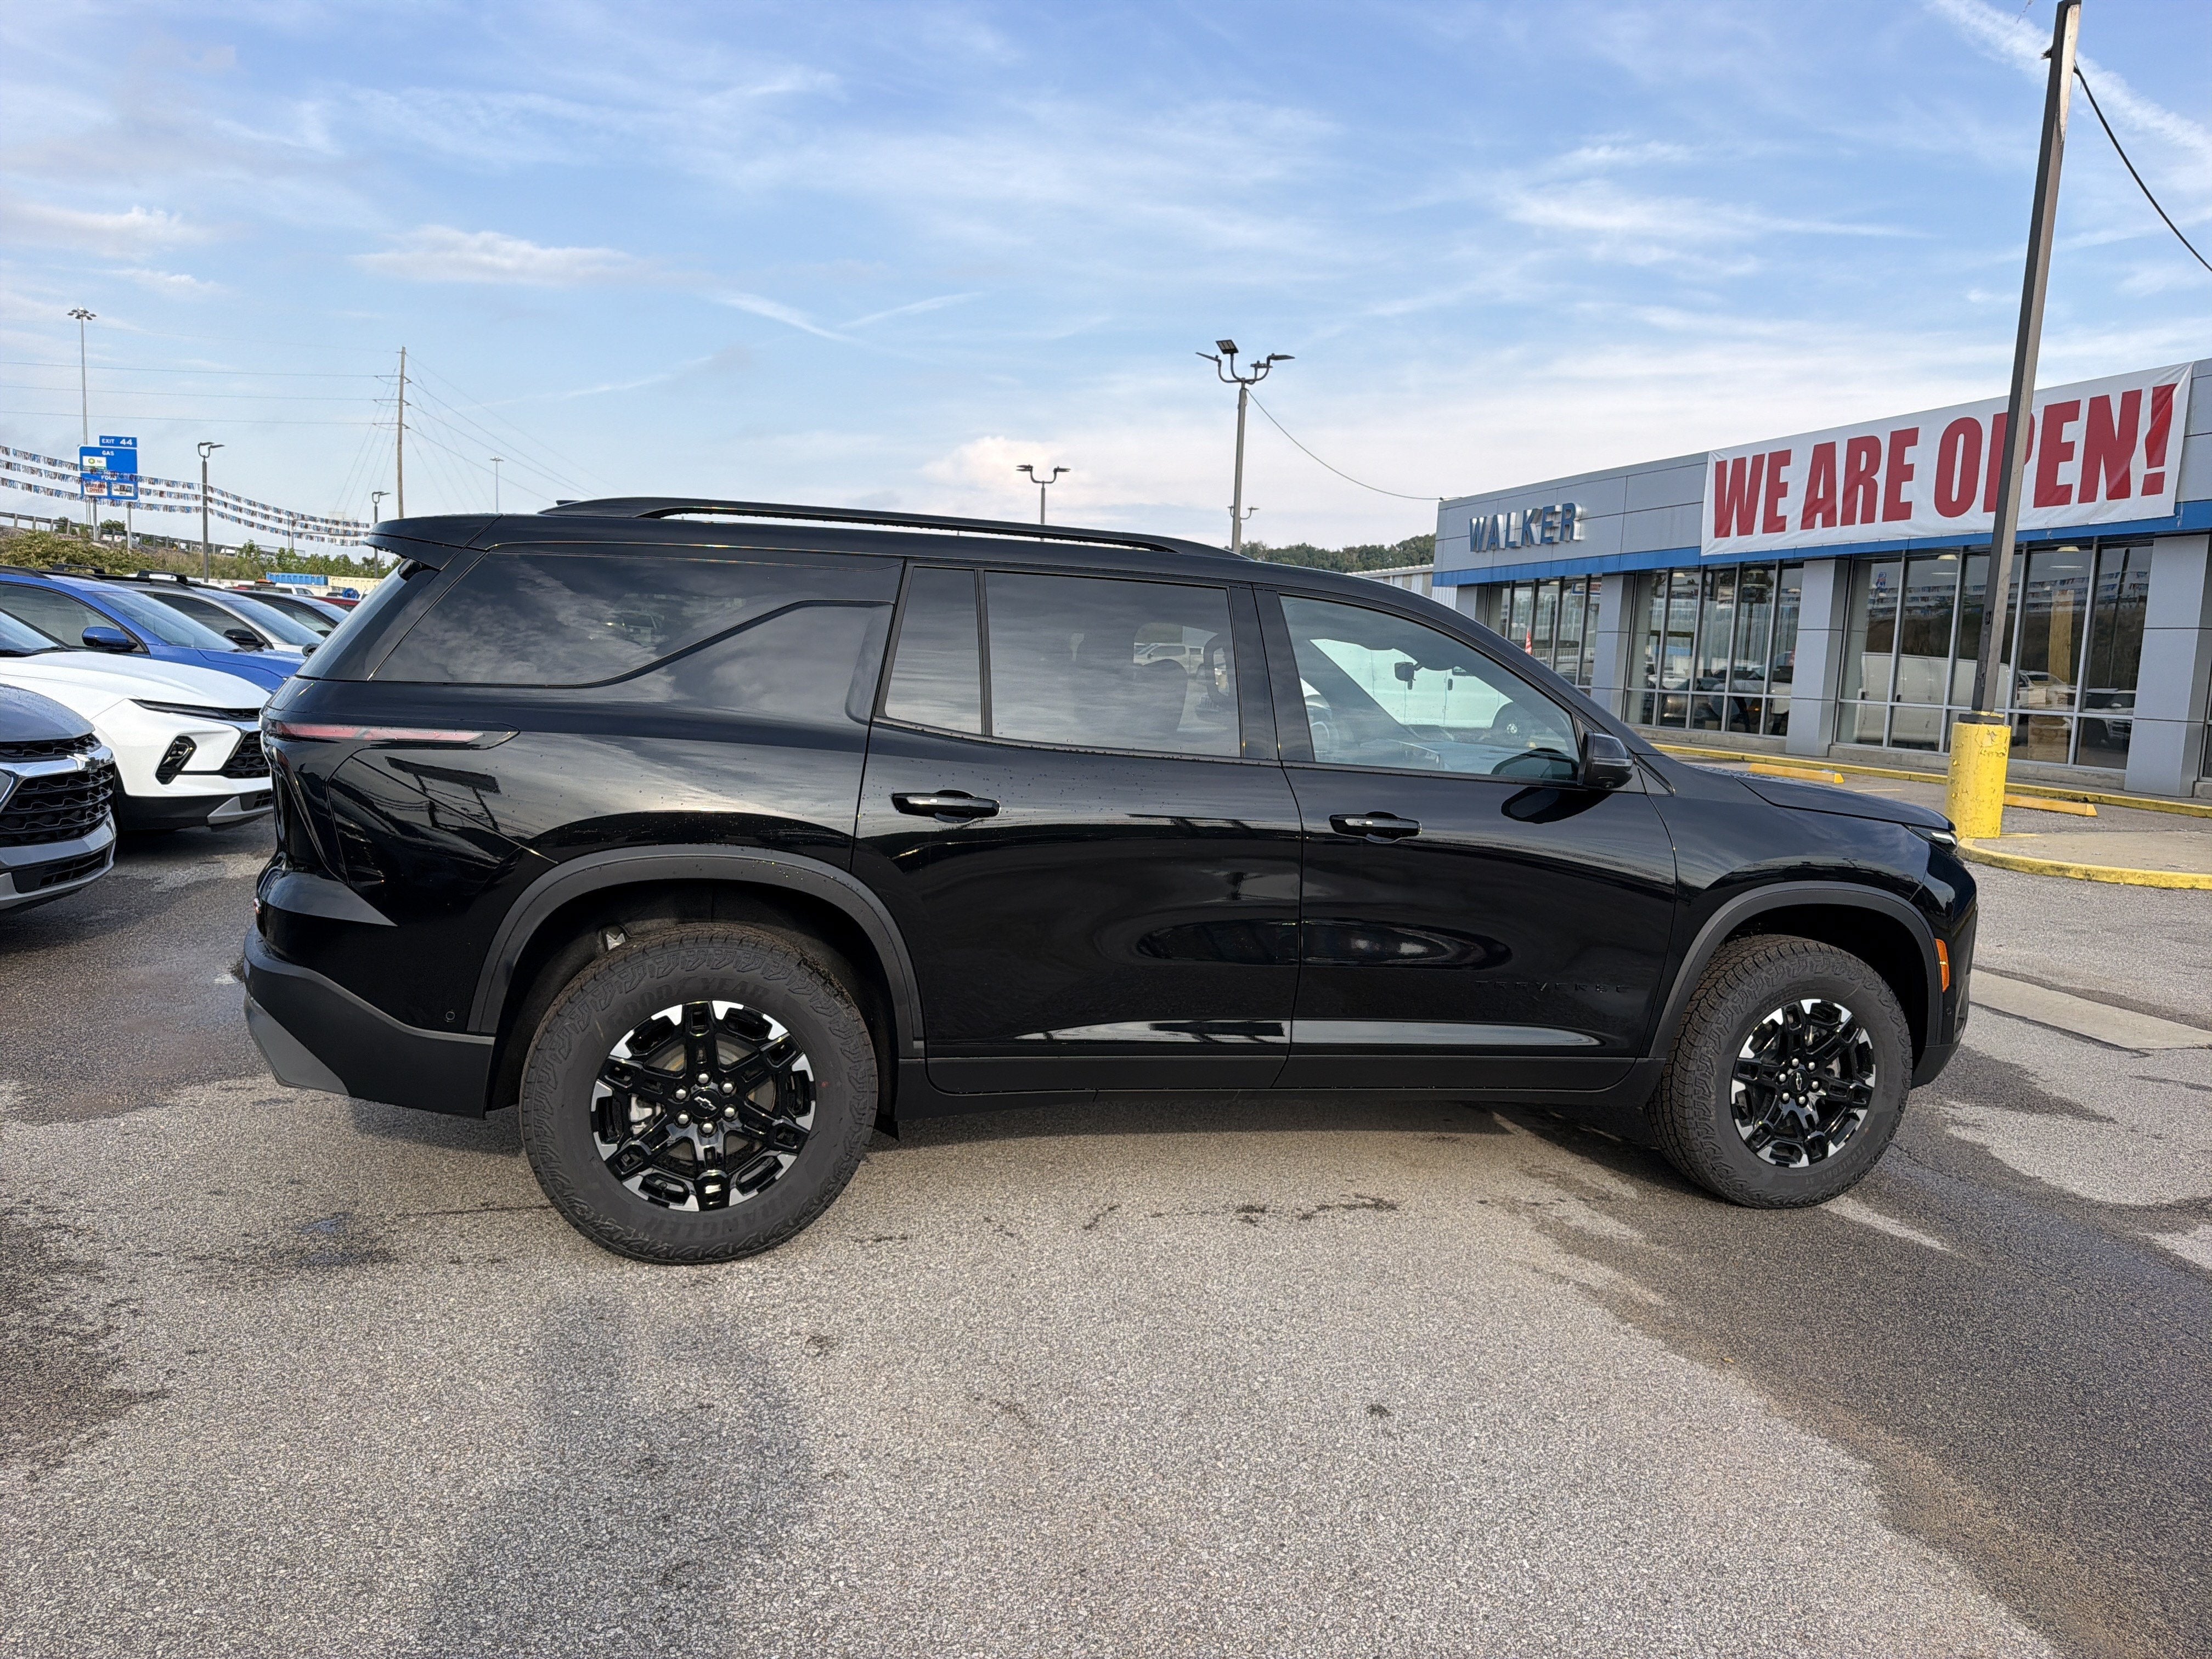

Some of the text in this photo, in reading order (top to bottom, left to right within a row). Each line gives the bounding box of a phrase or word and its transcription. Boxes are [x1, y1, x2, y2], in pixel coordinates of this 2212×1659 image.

[1715, 383, 2177, 538] WE ARE OPEN!
[1469, 503, 1583, 552] WALKER
